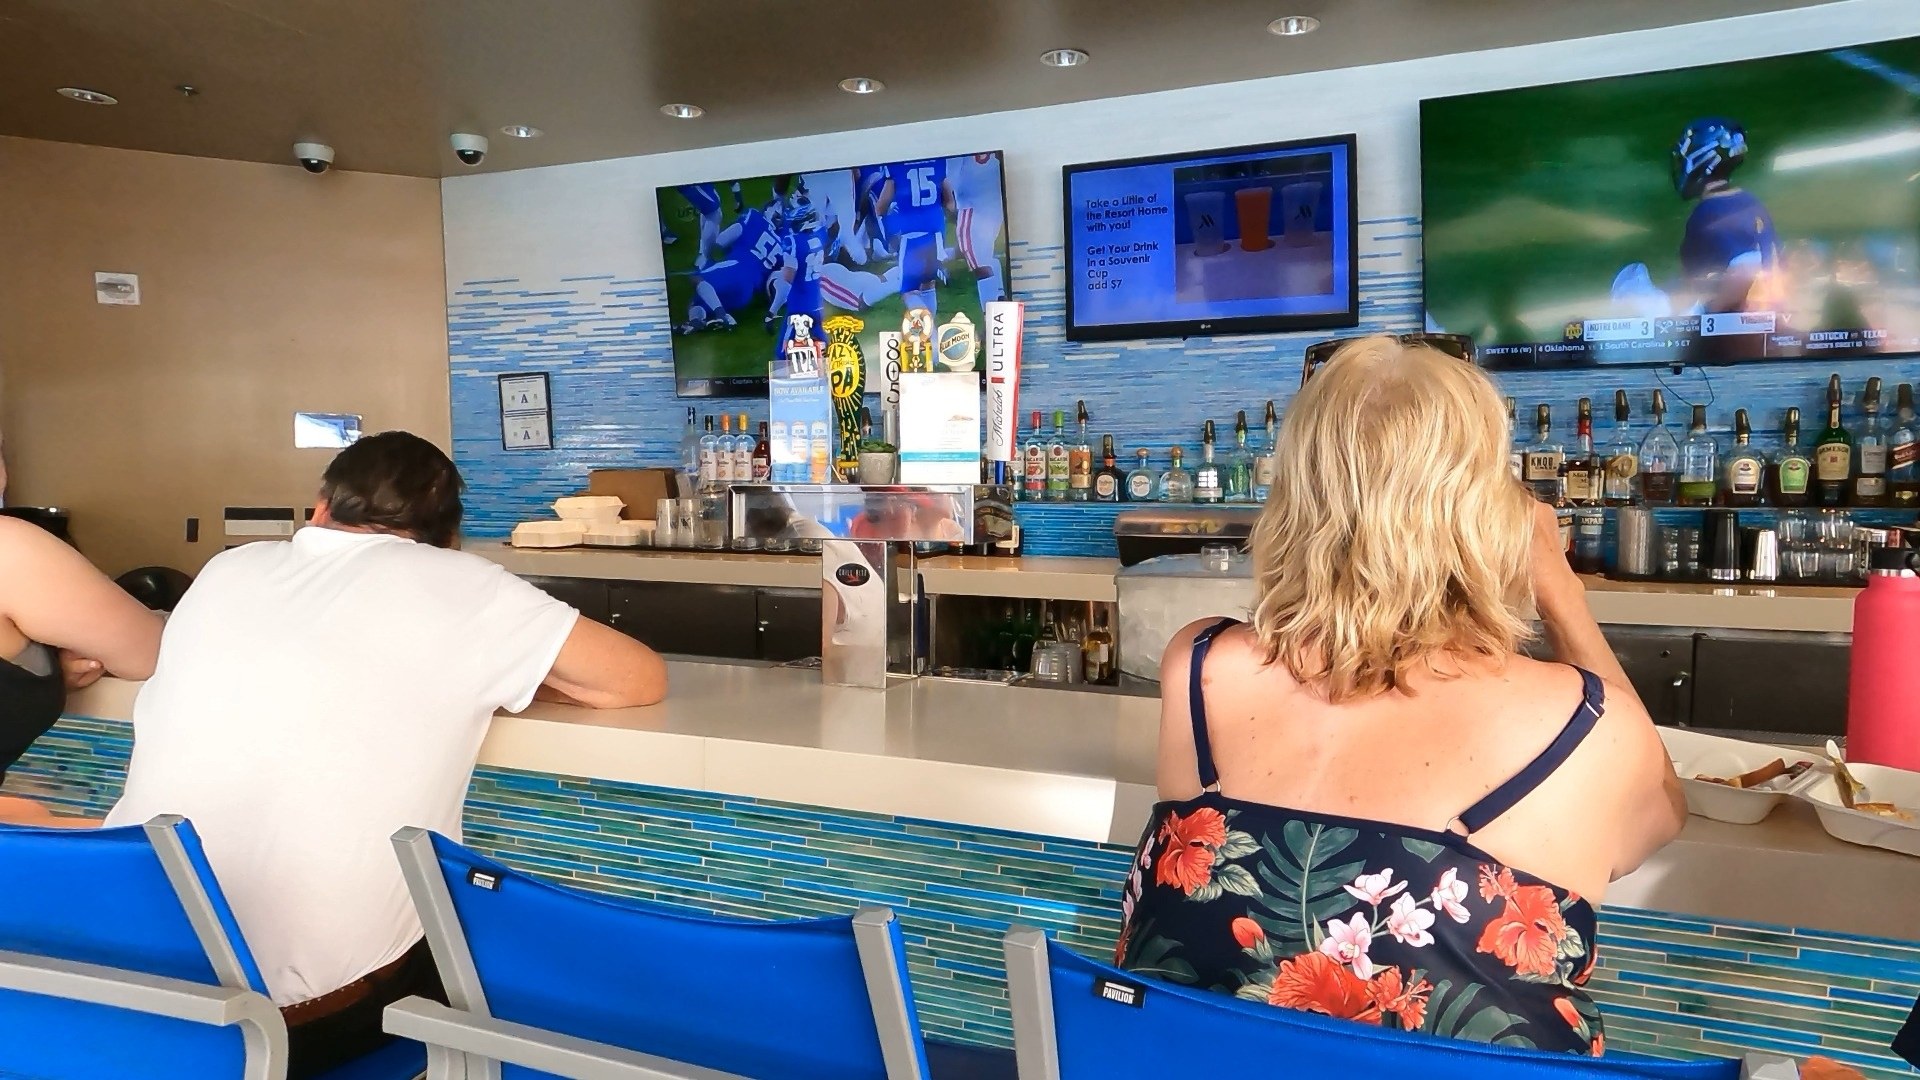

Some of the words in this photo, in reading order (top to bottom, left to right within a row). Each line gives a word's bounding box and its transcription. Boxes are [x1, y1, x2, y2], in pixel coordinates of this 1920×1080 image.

[907, 167, 937, 206] 15
[1087, 198, 1109, 209] Take
[1122, 195, 1145, 206] Little
[1147, 192, 1158, 203] of
[1087, 211, 1103, 221] the
[1105, 208, 1136, 219] Resort
[1138, 206, 1168, 216] Home
[1086, 221, 1107, 233] with
[1109, 220, 1131, 232] you!
[1087, 245, 1106, 256] Get
[1108, 243, 1131, 255] Your
[1133, 241, 1159, 252] Drink
[1108, 254, 1150, 266] Souvenir
[1087, 269, 1108, 280] Cup
[1087, 281, 1108, 291] add
[1111, 279, 1123, 290] $7
[1641, 320, 1649, 336] 3
[1706, 317, 1715, 333] 3
[951, 332, 970, 345] MOON
[992, 312, 1004, 372] ULTRA
[1544, 344, 1585, 353] Oklahoma
[1604, 342, 1629, 350] South
[1631, 339, 1665, 349] Carolina
[830, 343, 854, 358] AZY
[886, 338, 900, 404] 805
[831, 366, 853, 395] PA
[521, 393, 529, 404] A
[992, 388, 1004, 447] Michelob
[523, 429, 531, 440] A
[1103, 986, 1134, 1005] PAVILION
